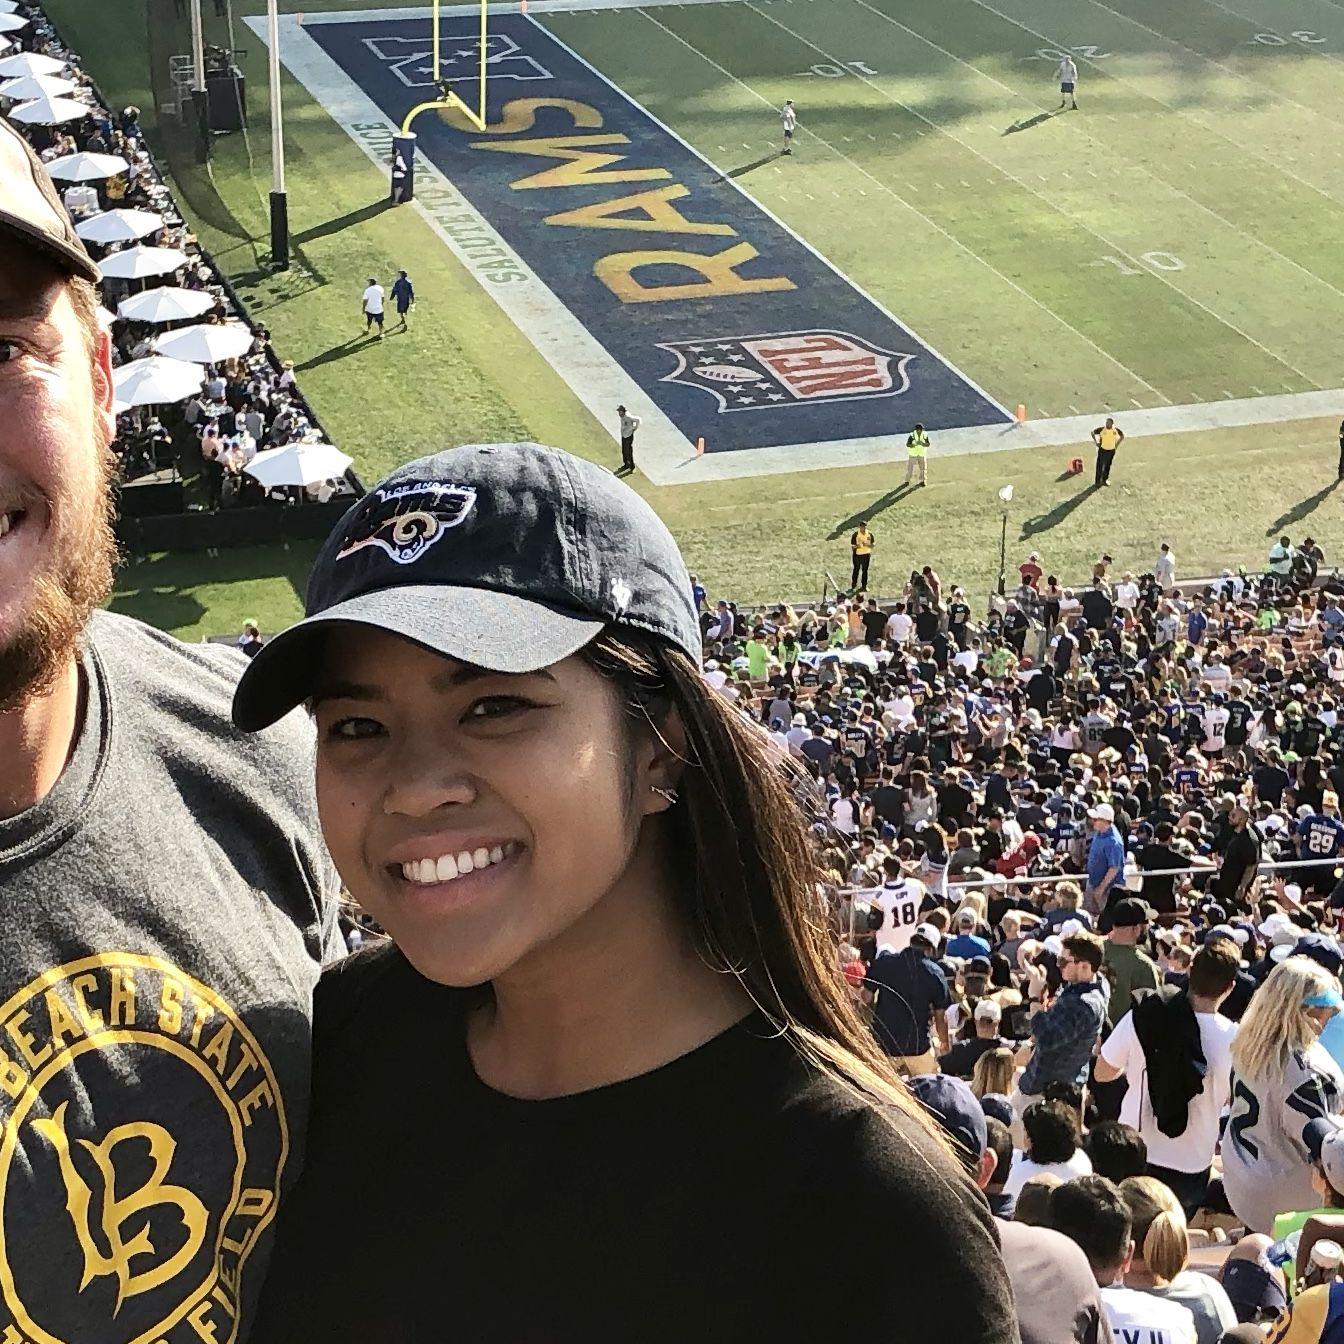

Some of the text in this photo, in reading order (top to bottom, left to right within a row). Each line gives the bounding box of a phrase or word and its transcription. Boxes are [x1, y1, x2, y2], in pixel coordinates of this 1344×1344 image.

[440, 96, 799, 304] RAMS
[756, 334, 888, 396] NFL
[1308, 830, 1334, 854] 29
[890, 902, 916, 929] 18
[157, 979, 274, 1128] STATE
[28, 1099, 211, 1321] LB
